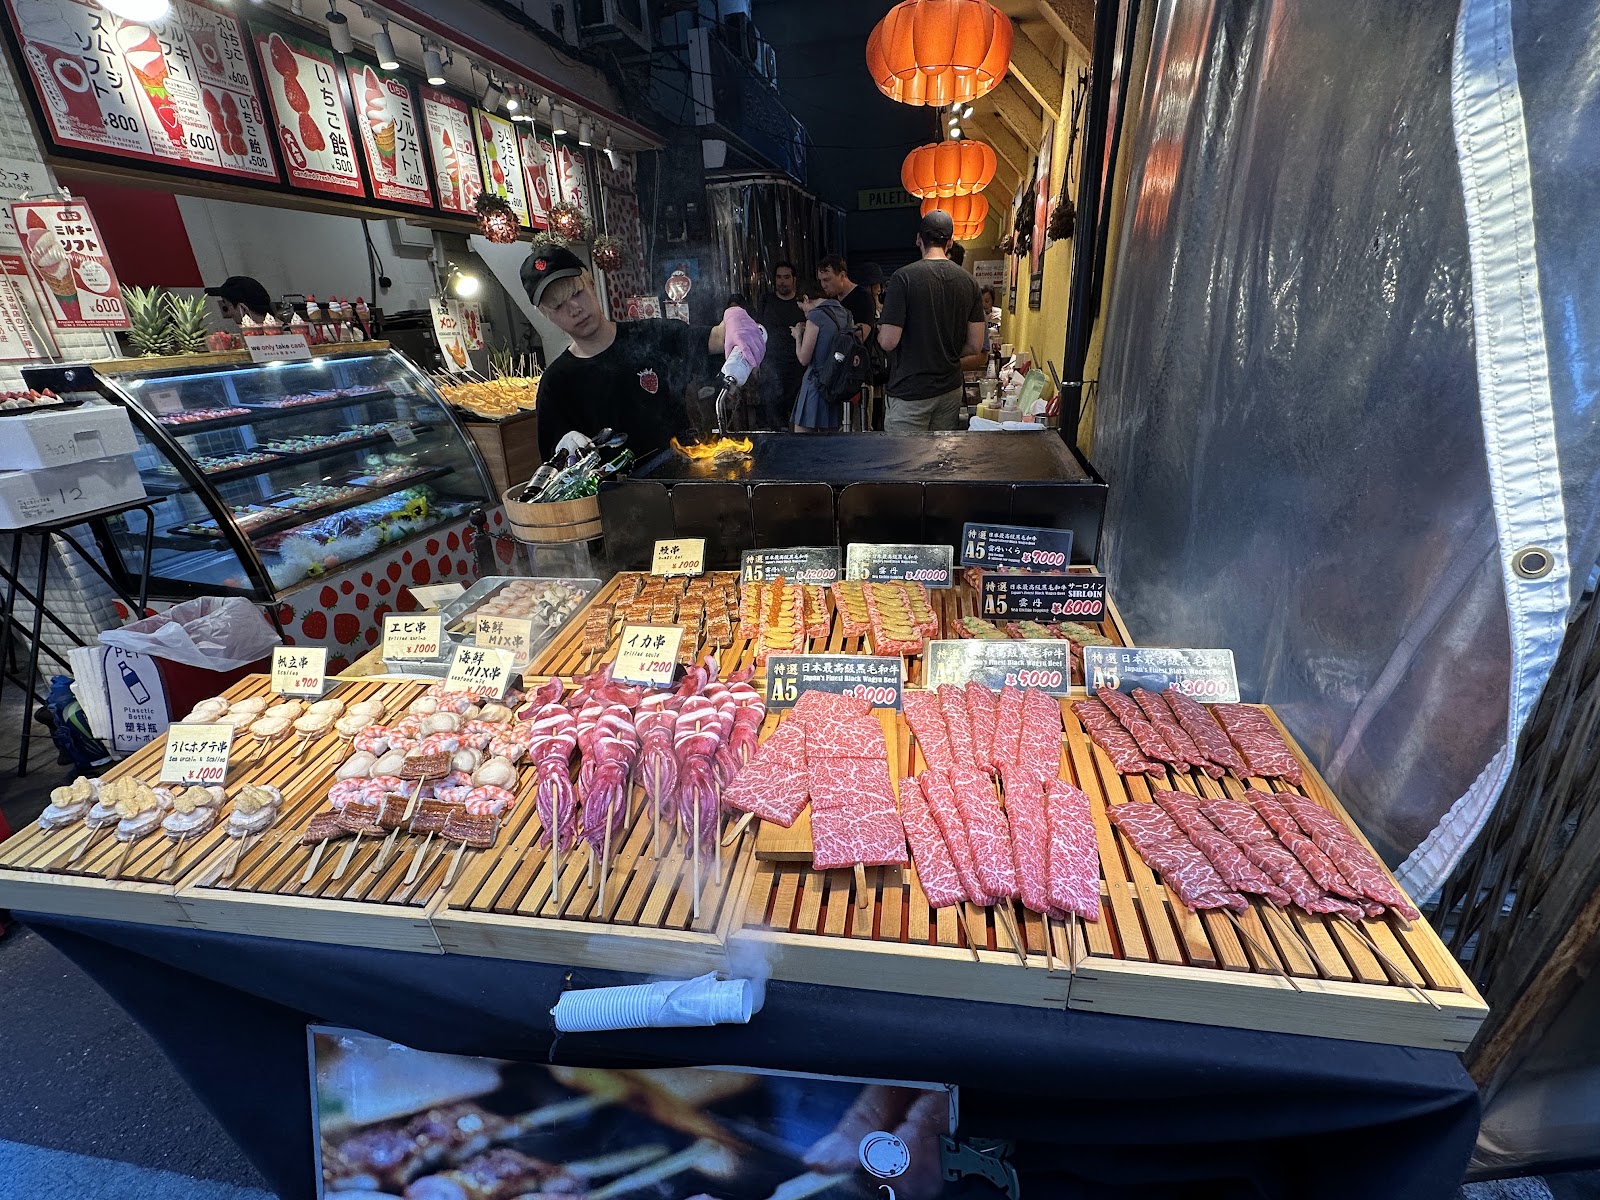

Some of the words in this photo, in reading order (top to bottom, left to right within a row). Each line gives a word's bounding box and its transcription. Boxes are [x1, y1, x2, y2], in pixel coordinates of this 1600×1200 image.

[214, 14, 235, 70] スムージー
[224, 18, 244, 62] いちご
[74, 31, 110, 98] ソフト
[87, 12, 125, 105] スムージー
[314, 63, 349, 158] いちご飴
[103, 112, 139, 133] ¥800
[183, 132, 215, 151] ¥600
[392, 116, 412, 171] ソフト
[400, 101, 420, 174] ミルキー
[331, 158, 353, 173] ¥500
[54, 225, 93, 236] ミルキー
[60, 238, 98, 252] ソフト
[89, 298, 120, 313] ¥600
[439, 316, 457, 329] メロン
[261, 344, 275, 352] only
[59, 487, 87, 504] 12
[967, 529, 988, 540] 特選
[964, 540, 986, 559] A5
[671, 560, 700, 569] ¥1000
[1021, 549, 1066, 566] ¥7000
[743, 564, 764, 582] A5
[796, 568, 837, 580] ¥12000
[904, 568, 948, 582] ¥10000
[984, 580, 1008, 593] 特選
[1009, 583, 1068, 591] 日本最高級黒毛和牛
[1067, 582, 1104, 590] サーロイン
[1068, 590, 1103, 598] SIRLOIN
[984, 594, 1008, 615] A5
[1050, 599, 1103, 615] ¥6000
[390, 621, 427, 634] エビ串
[479, 619, 504, 634] 海鮮
[406, 643, 437, 654] ¥1000
[488, 635, 525, 648] MIX串
[627, 633, 666, 650] イカ串
[277, 655, 309, 669] 帆立串
[459, 650, 486, 666] 海鮮
[1089, 652, 1119, 665] 特選
[464, 666, 502, 680] MIX串
[639, 661, 672, 673] ¥1200
[773, 662, 799, 676] 特選
[801, 662, 900, 675] 日本最高級黒毛和牛
[934, 662, 961, 684] A5
[1124, 665, 1148, 673] Japan's
[295, 677, 319, 688] ¥700
[1005, 669, 1062, 687] ¥5000
[1091, 666, 1120, 690] A5
[467, 685, 499, 697] ¥1000
[771, 677, 798, 701] A5
[843, 684, 897, 705] ¥8000
[128, 713, 151, 721] Bottle
[125, 722, 158, 734] 塑料瓶
[171, 741, 228, 753] うにホタテ串
[187, 767, 224, 780] ¥1000
